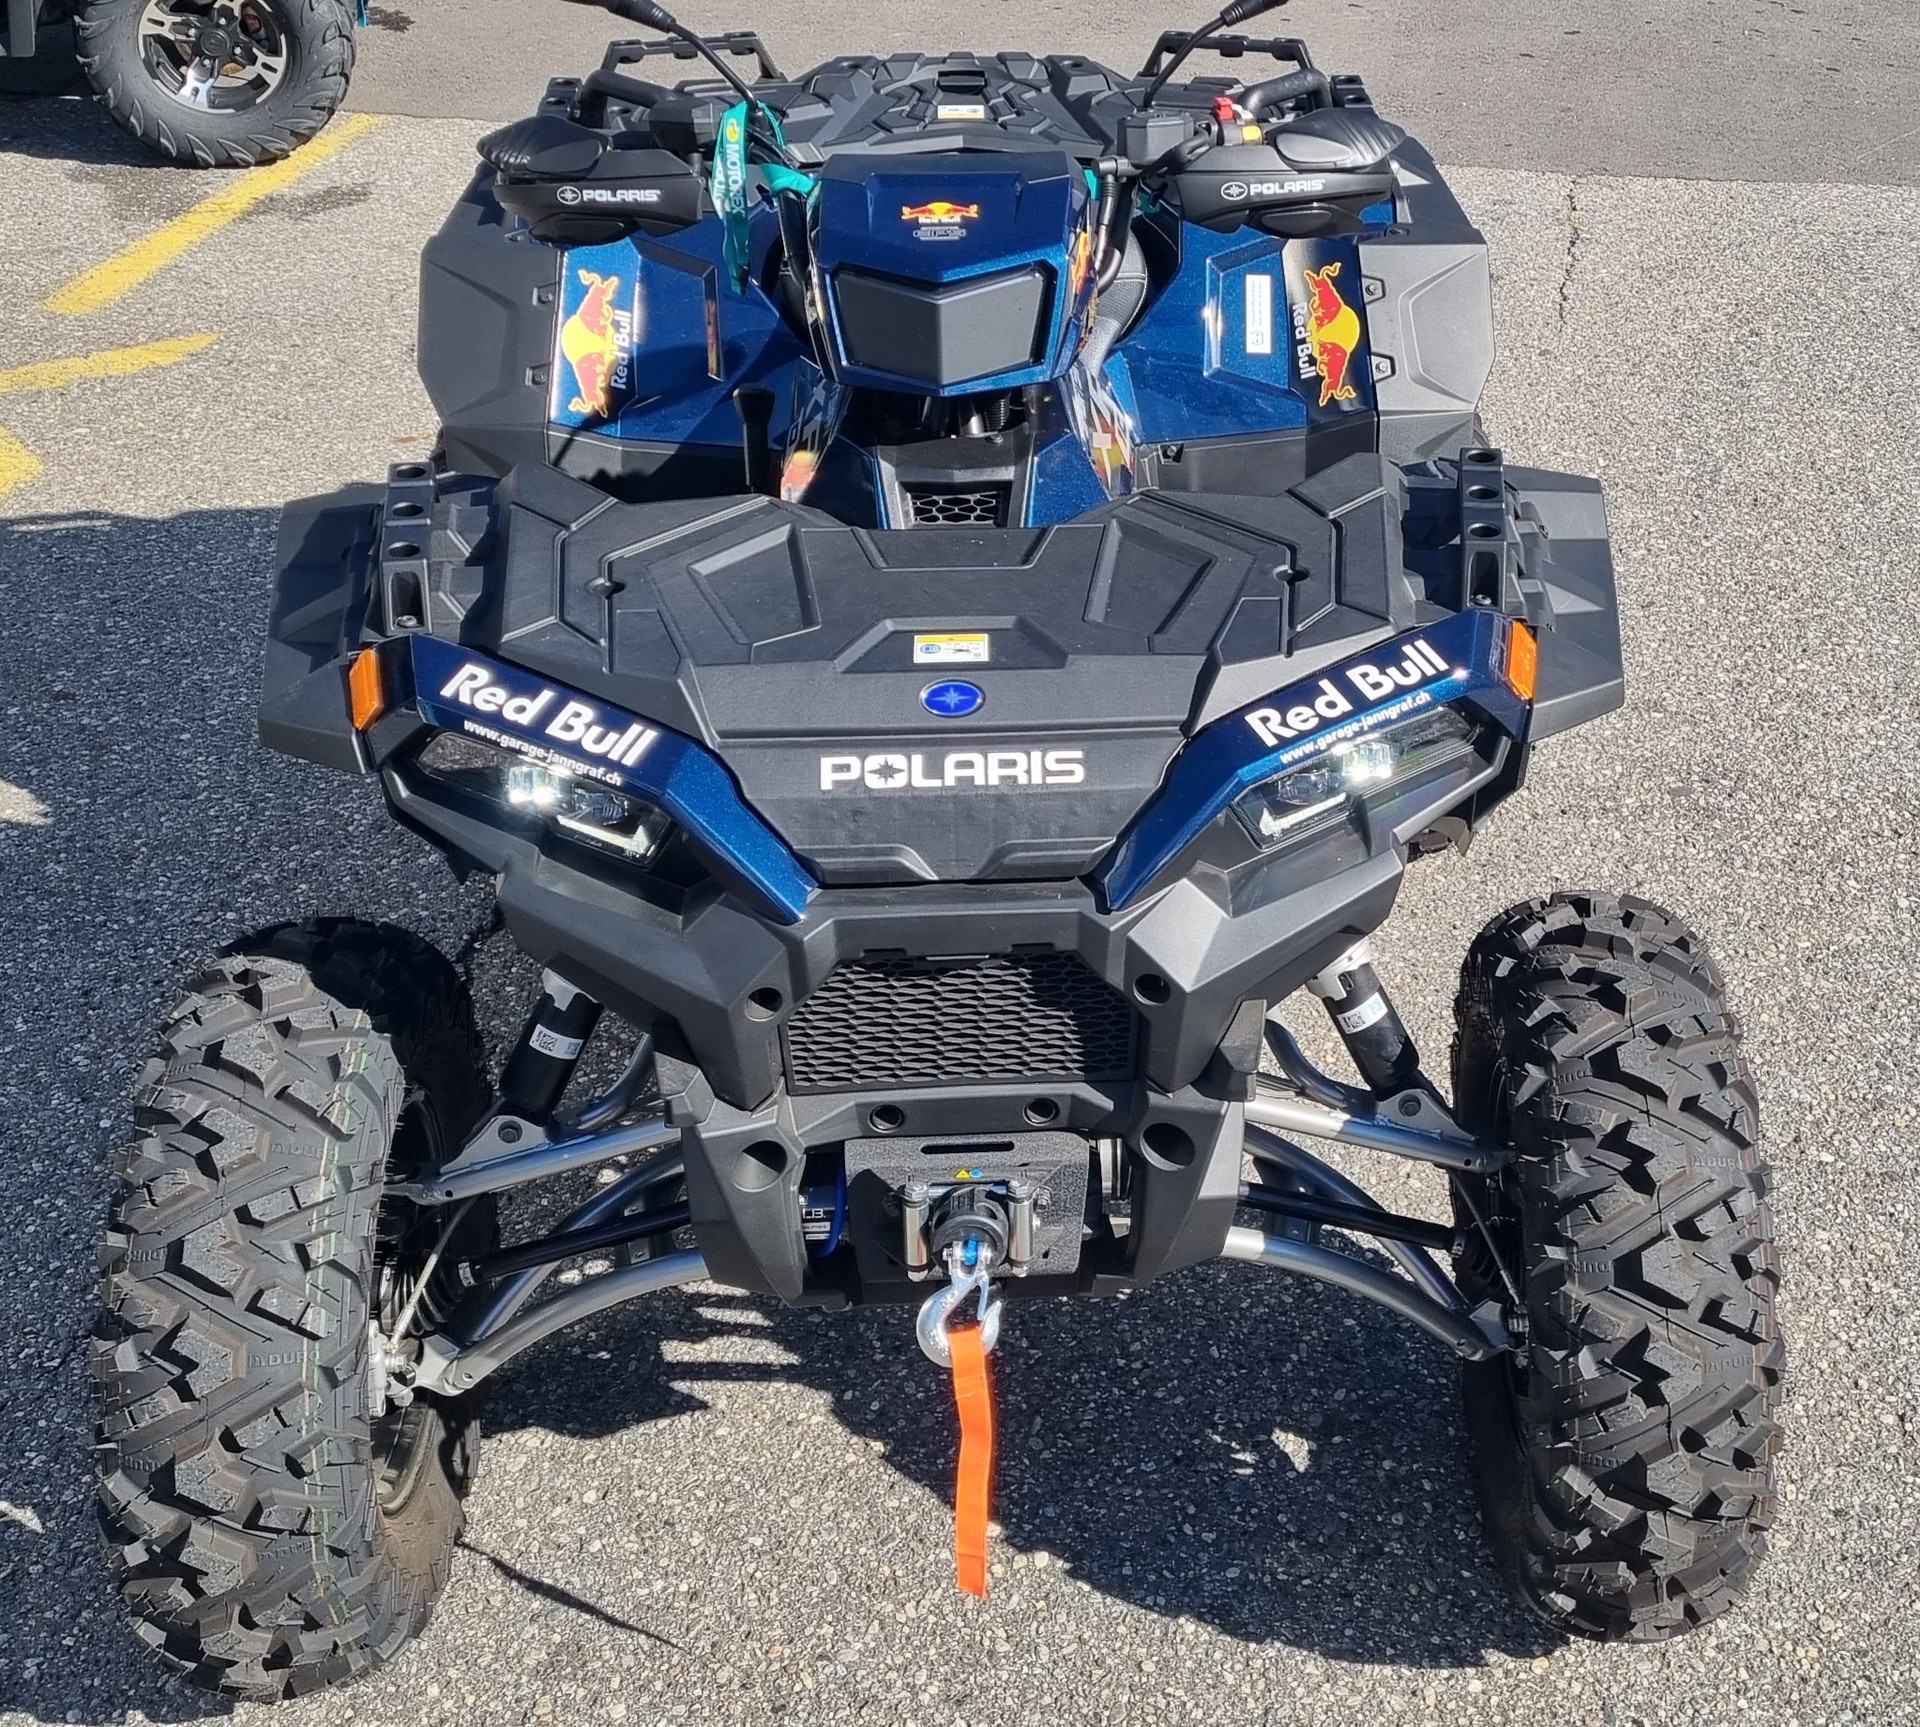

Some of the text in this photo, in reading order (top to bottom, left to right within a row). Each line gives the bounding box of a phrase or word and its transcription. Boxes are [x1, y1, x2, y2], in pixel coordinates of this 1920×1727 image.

[582, 189, 660, 202] POLARIS
[726, 144, 745, 214] MOTOREX
[1250, 179, 1324, 195] POLARIS
[611, 309, 632, 390] Red Bull
[1292, 301, 1317, 379] Red Bull
[439, 663, 659, 767] Red Bull
[1244, 639, 1450, 748] Red Bull
[1280, 691, 1431, 764] www.garage-janngraf.ch
[464, 720, 621, 787] www.garage-janngraf.ch
[820, 750, 1085, 790] POLARIS
